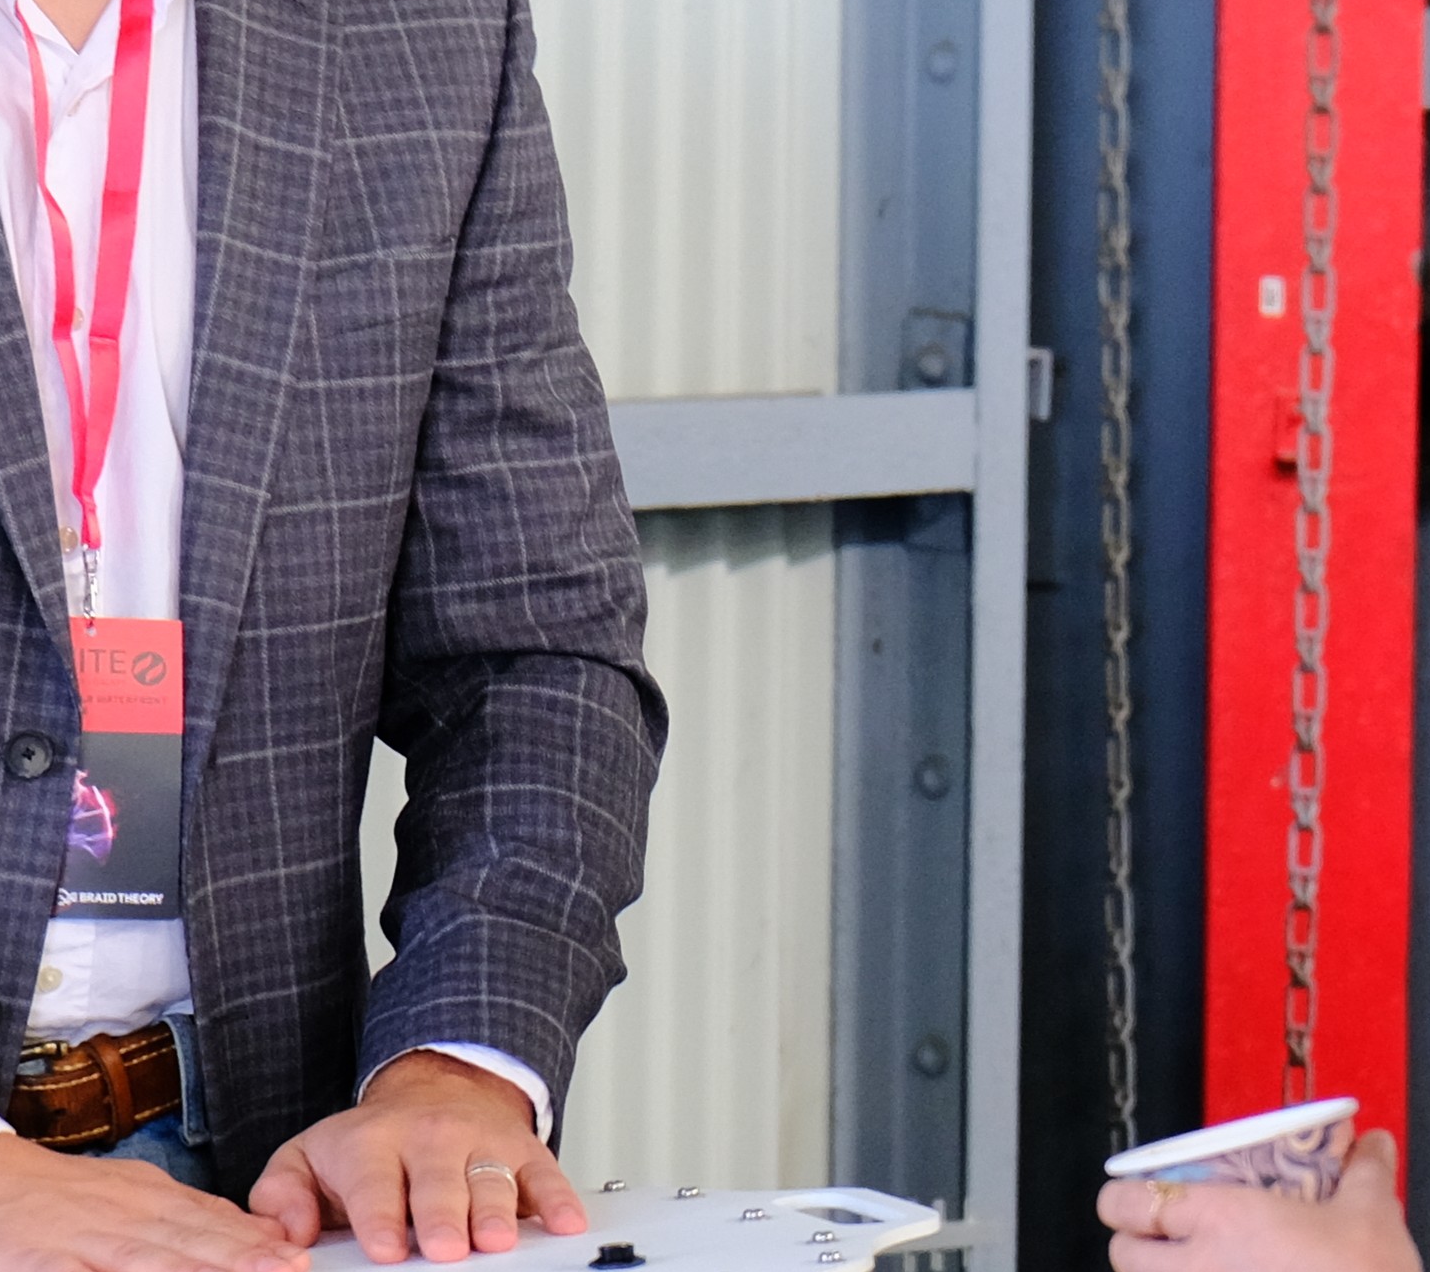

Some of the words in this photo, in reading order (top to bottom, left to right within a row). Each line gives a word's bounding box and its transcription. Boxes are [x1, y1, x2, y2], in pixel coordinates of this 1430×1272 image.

[79, 648, 127, 674] ITE
[79, 890, 117, 905] BRAID
[117, 891, 165, 906] THEORY
